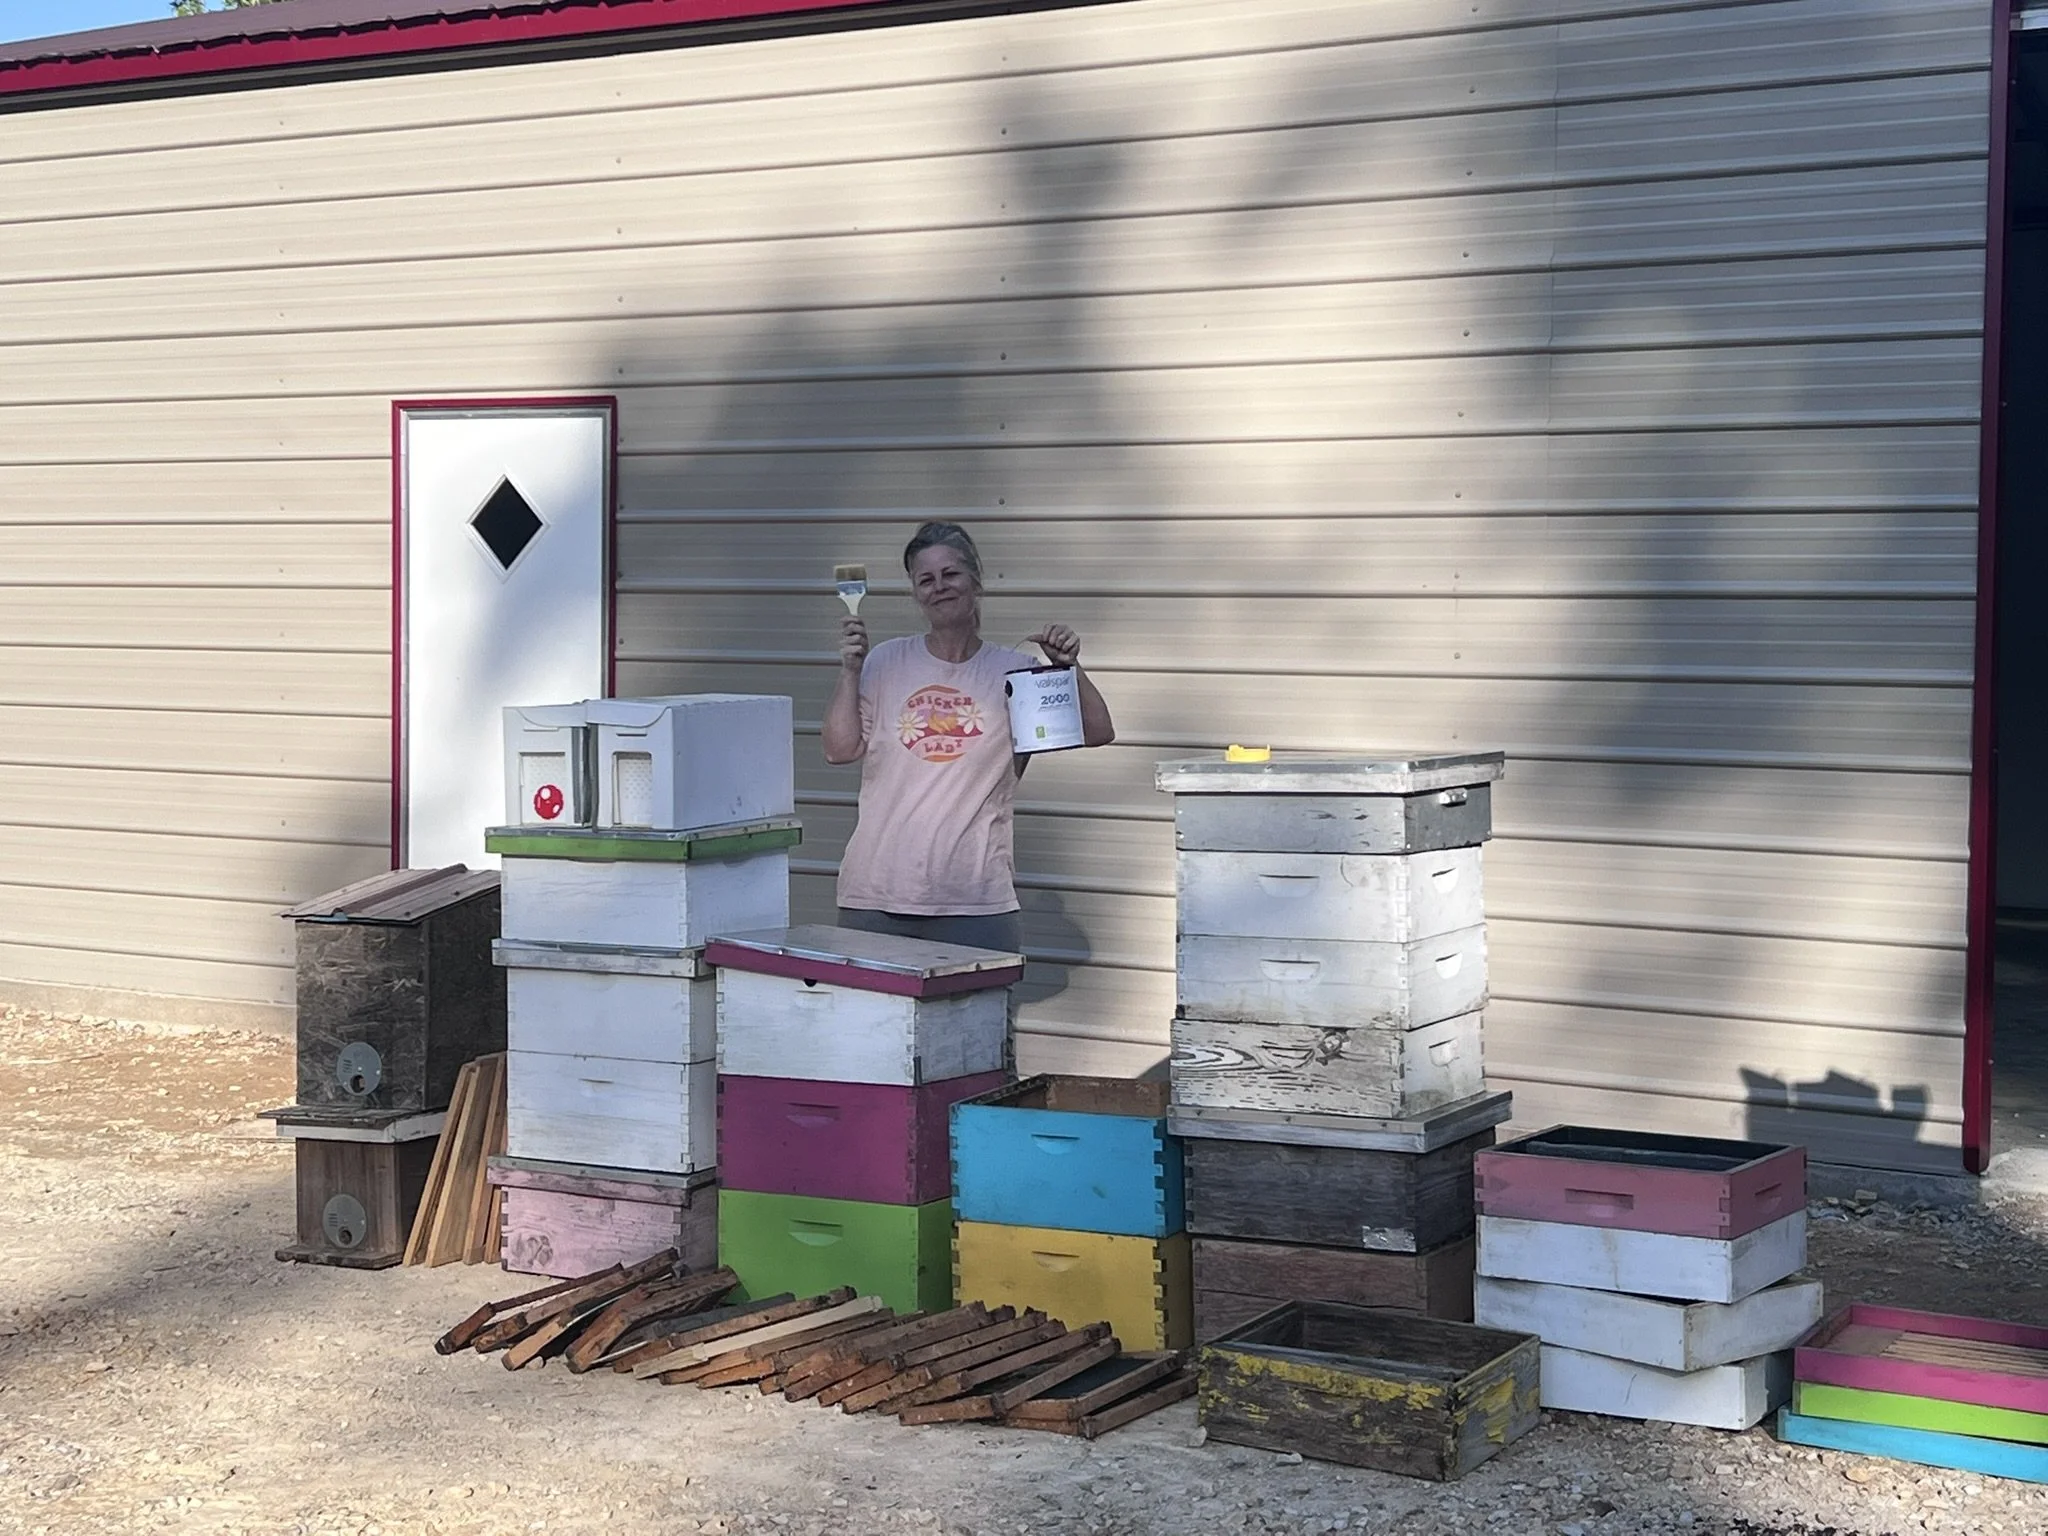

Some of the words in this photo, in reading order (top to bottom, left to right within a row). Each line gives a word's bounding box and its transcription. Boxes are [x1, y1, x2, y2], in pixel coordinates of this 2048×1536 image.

[1034, 676, 1070, 689] valspar
[907, 696, 972, 709] CHICKEN
[1040, 693, 1070, 705] 2000
[924, 739, 962, 753] LADY
